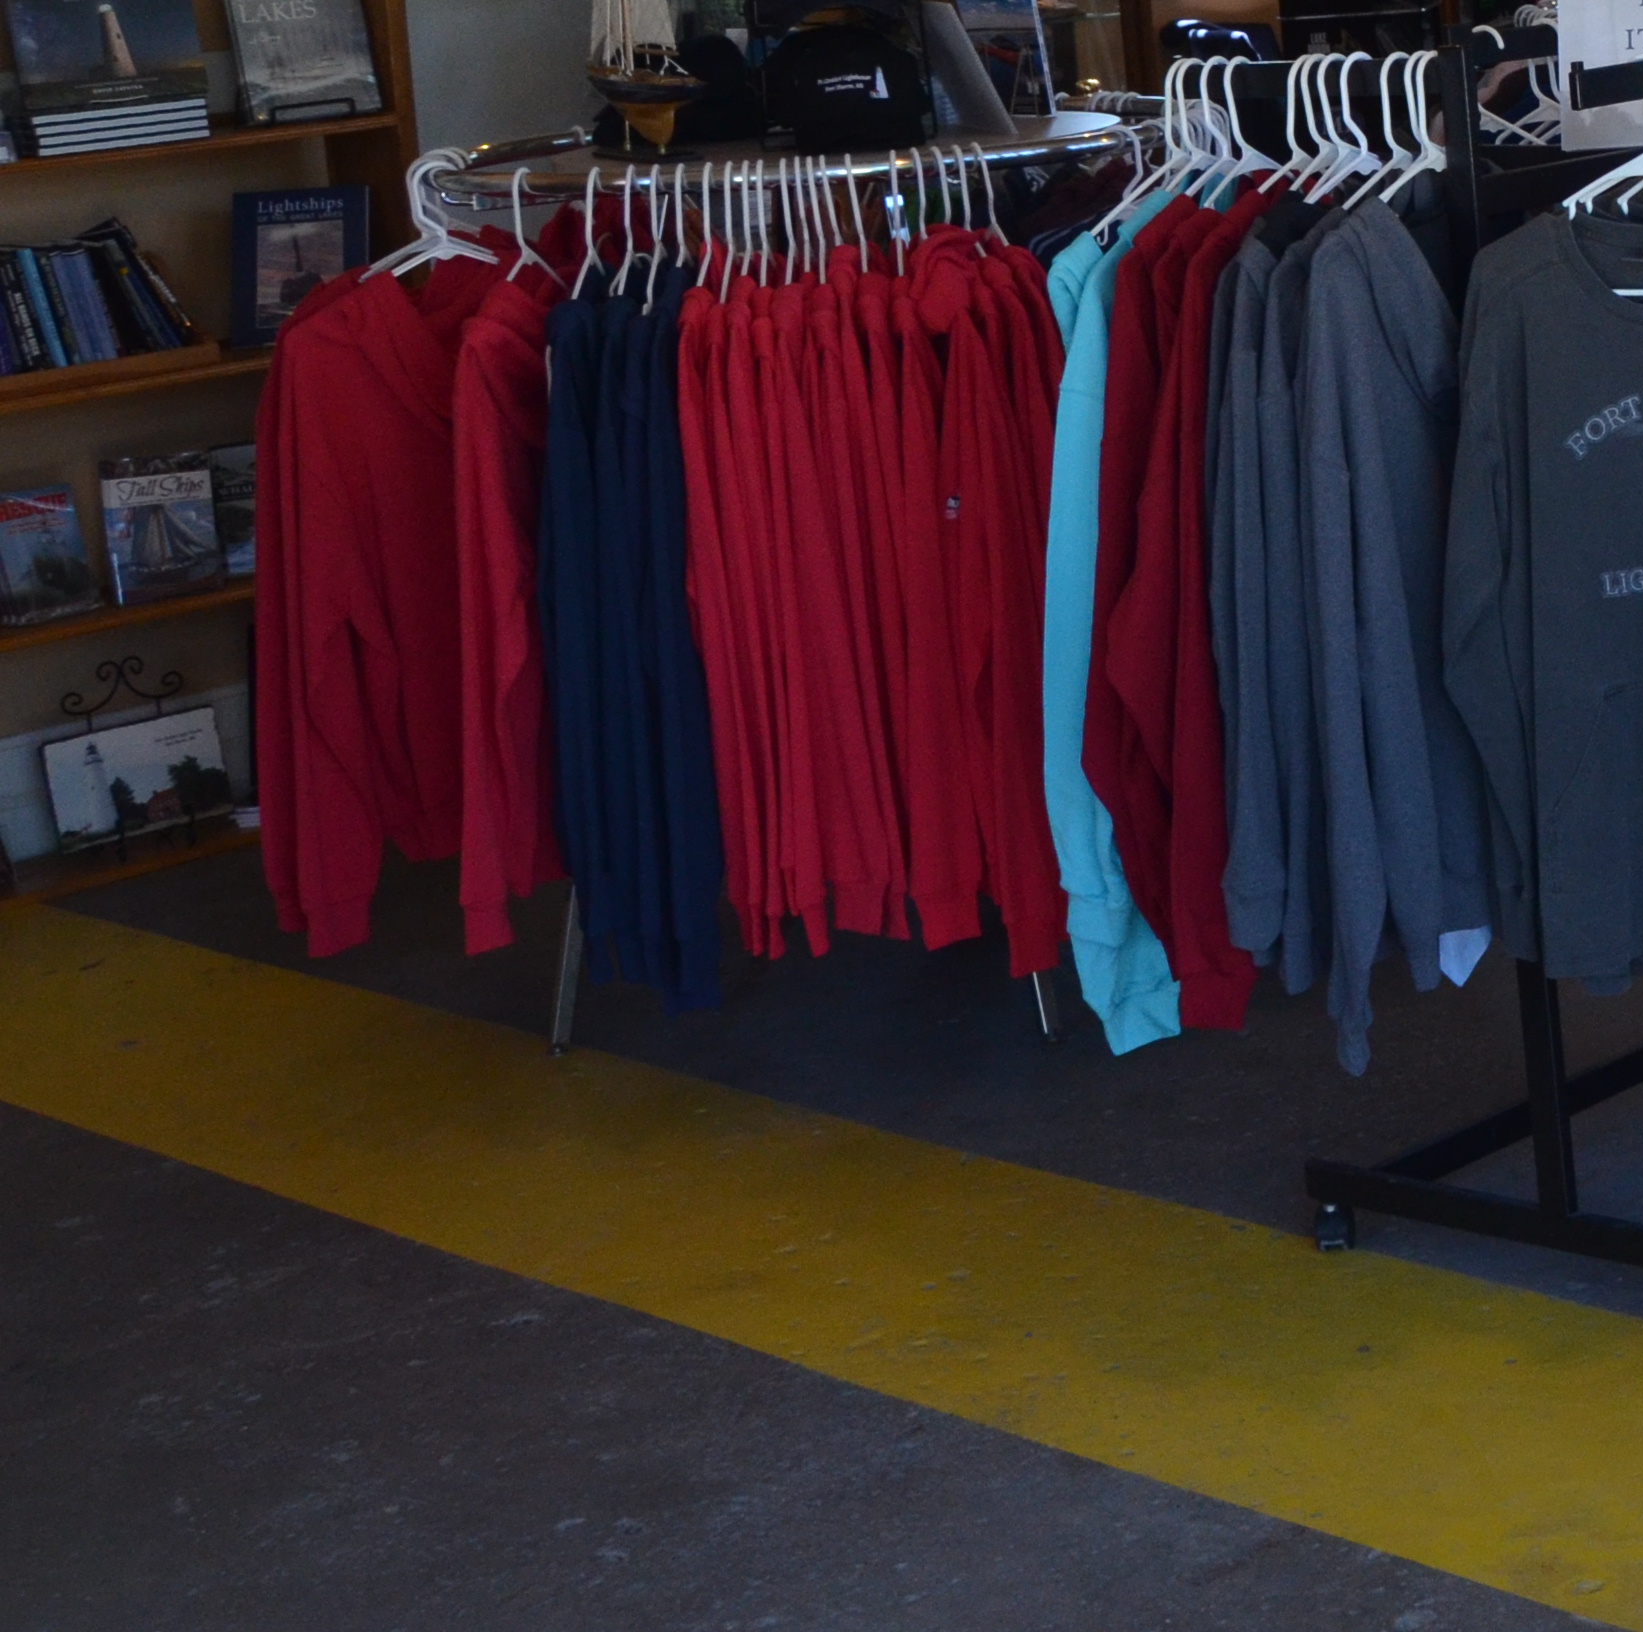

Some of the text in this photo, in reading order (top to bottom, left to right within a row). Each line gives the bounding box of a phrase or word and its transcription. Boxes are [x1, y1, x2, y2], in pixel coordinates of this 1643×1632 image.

[239, 0, 316, 24] LAKES
[258, 197, 343, 216] Lightships
[1566, 396, 1640, 458] FORT
[118, 475, 204, 501] Tall Ships
